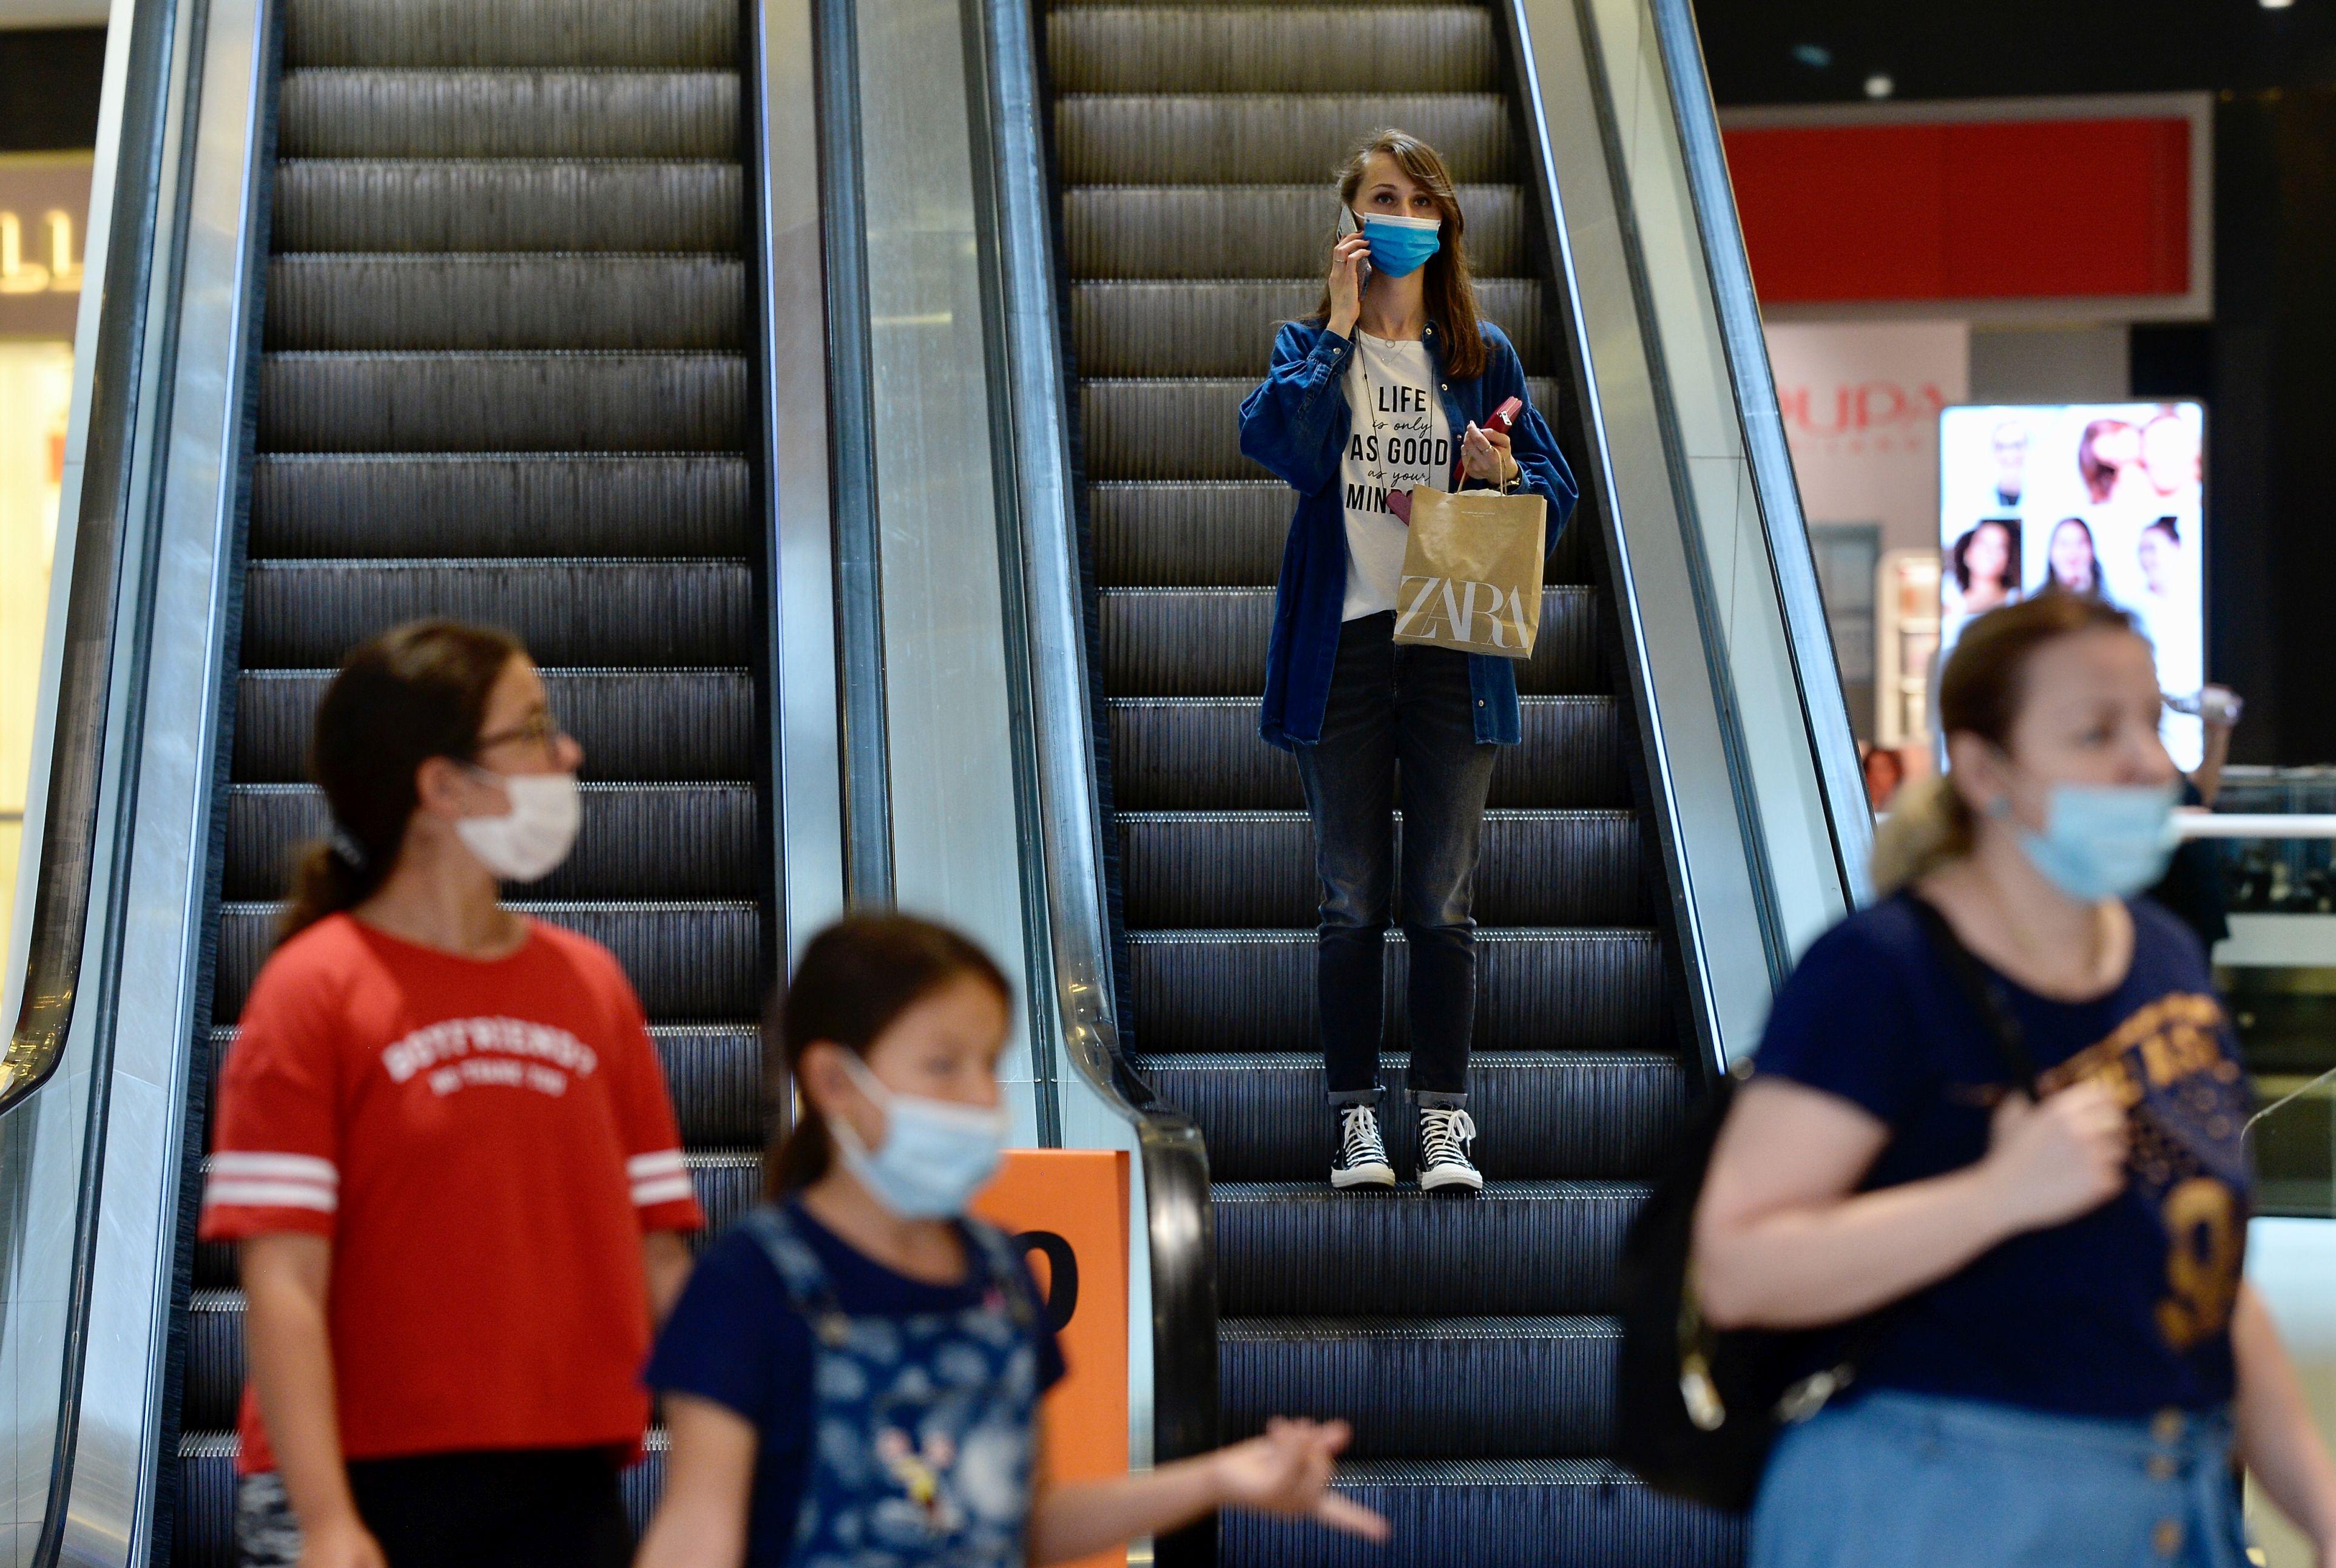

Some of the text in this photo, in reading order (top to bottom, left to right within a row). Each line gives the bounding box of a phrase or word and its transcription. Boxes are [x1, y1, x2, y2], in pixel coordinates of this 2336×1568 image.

[1379, 386, 1426, 413] LIFE
[1372, 416, 1433, 439] is only
[1350, 434, 1449, 466] AS GOOD
[1368, 470, 1431, 488] as your
[1394, 575, 1529, 649] ZARA
